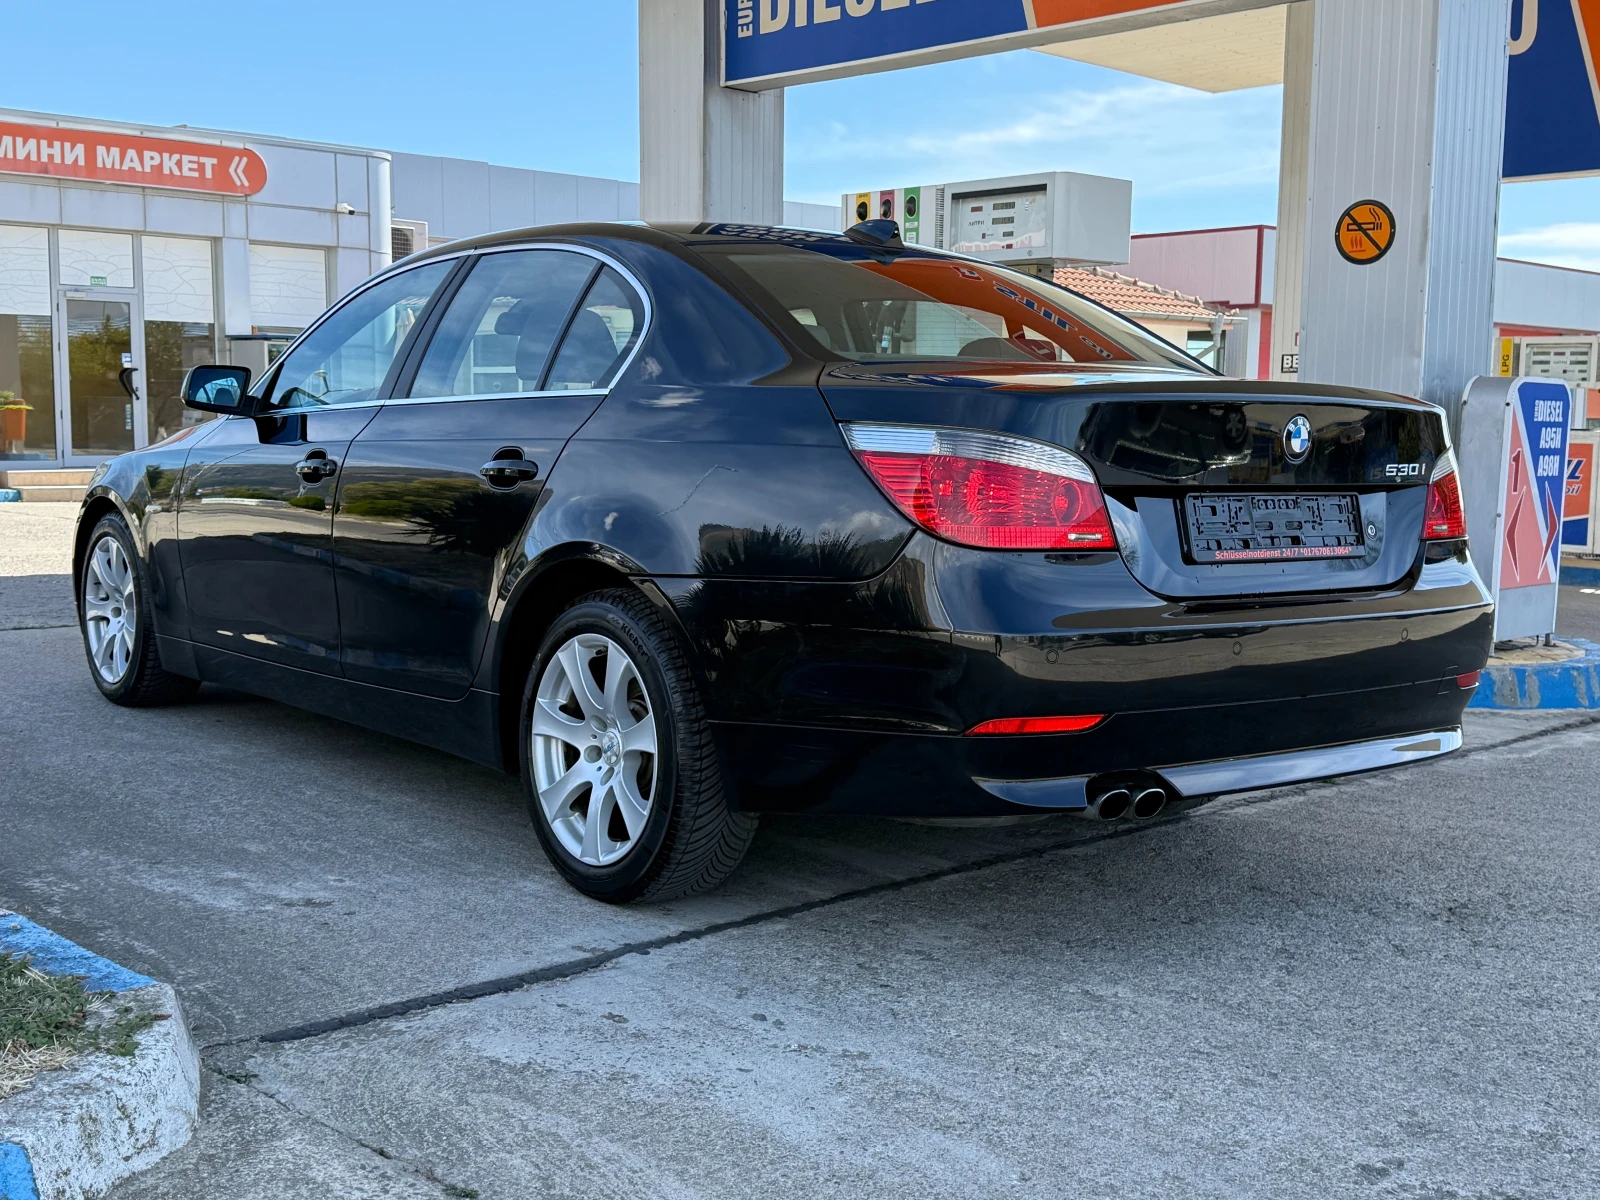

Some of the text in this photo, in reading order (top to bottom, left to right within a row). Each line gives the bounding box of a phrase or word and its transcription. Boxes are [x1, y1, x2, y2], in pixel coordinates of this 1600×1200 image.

[96, 145, 217, 179] МАРКЕТ
[1501, 354, 1510, 373] LPG
[1538, 400, 1563, 422] DIESEL
[1511, 448, 1521, 494] 1
[1215, 548, 1281, 560] Schlüsselnotdienst
[1282, 548, 1299, 558] 24/7
